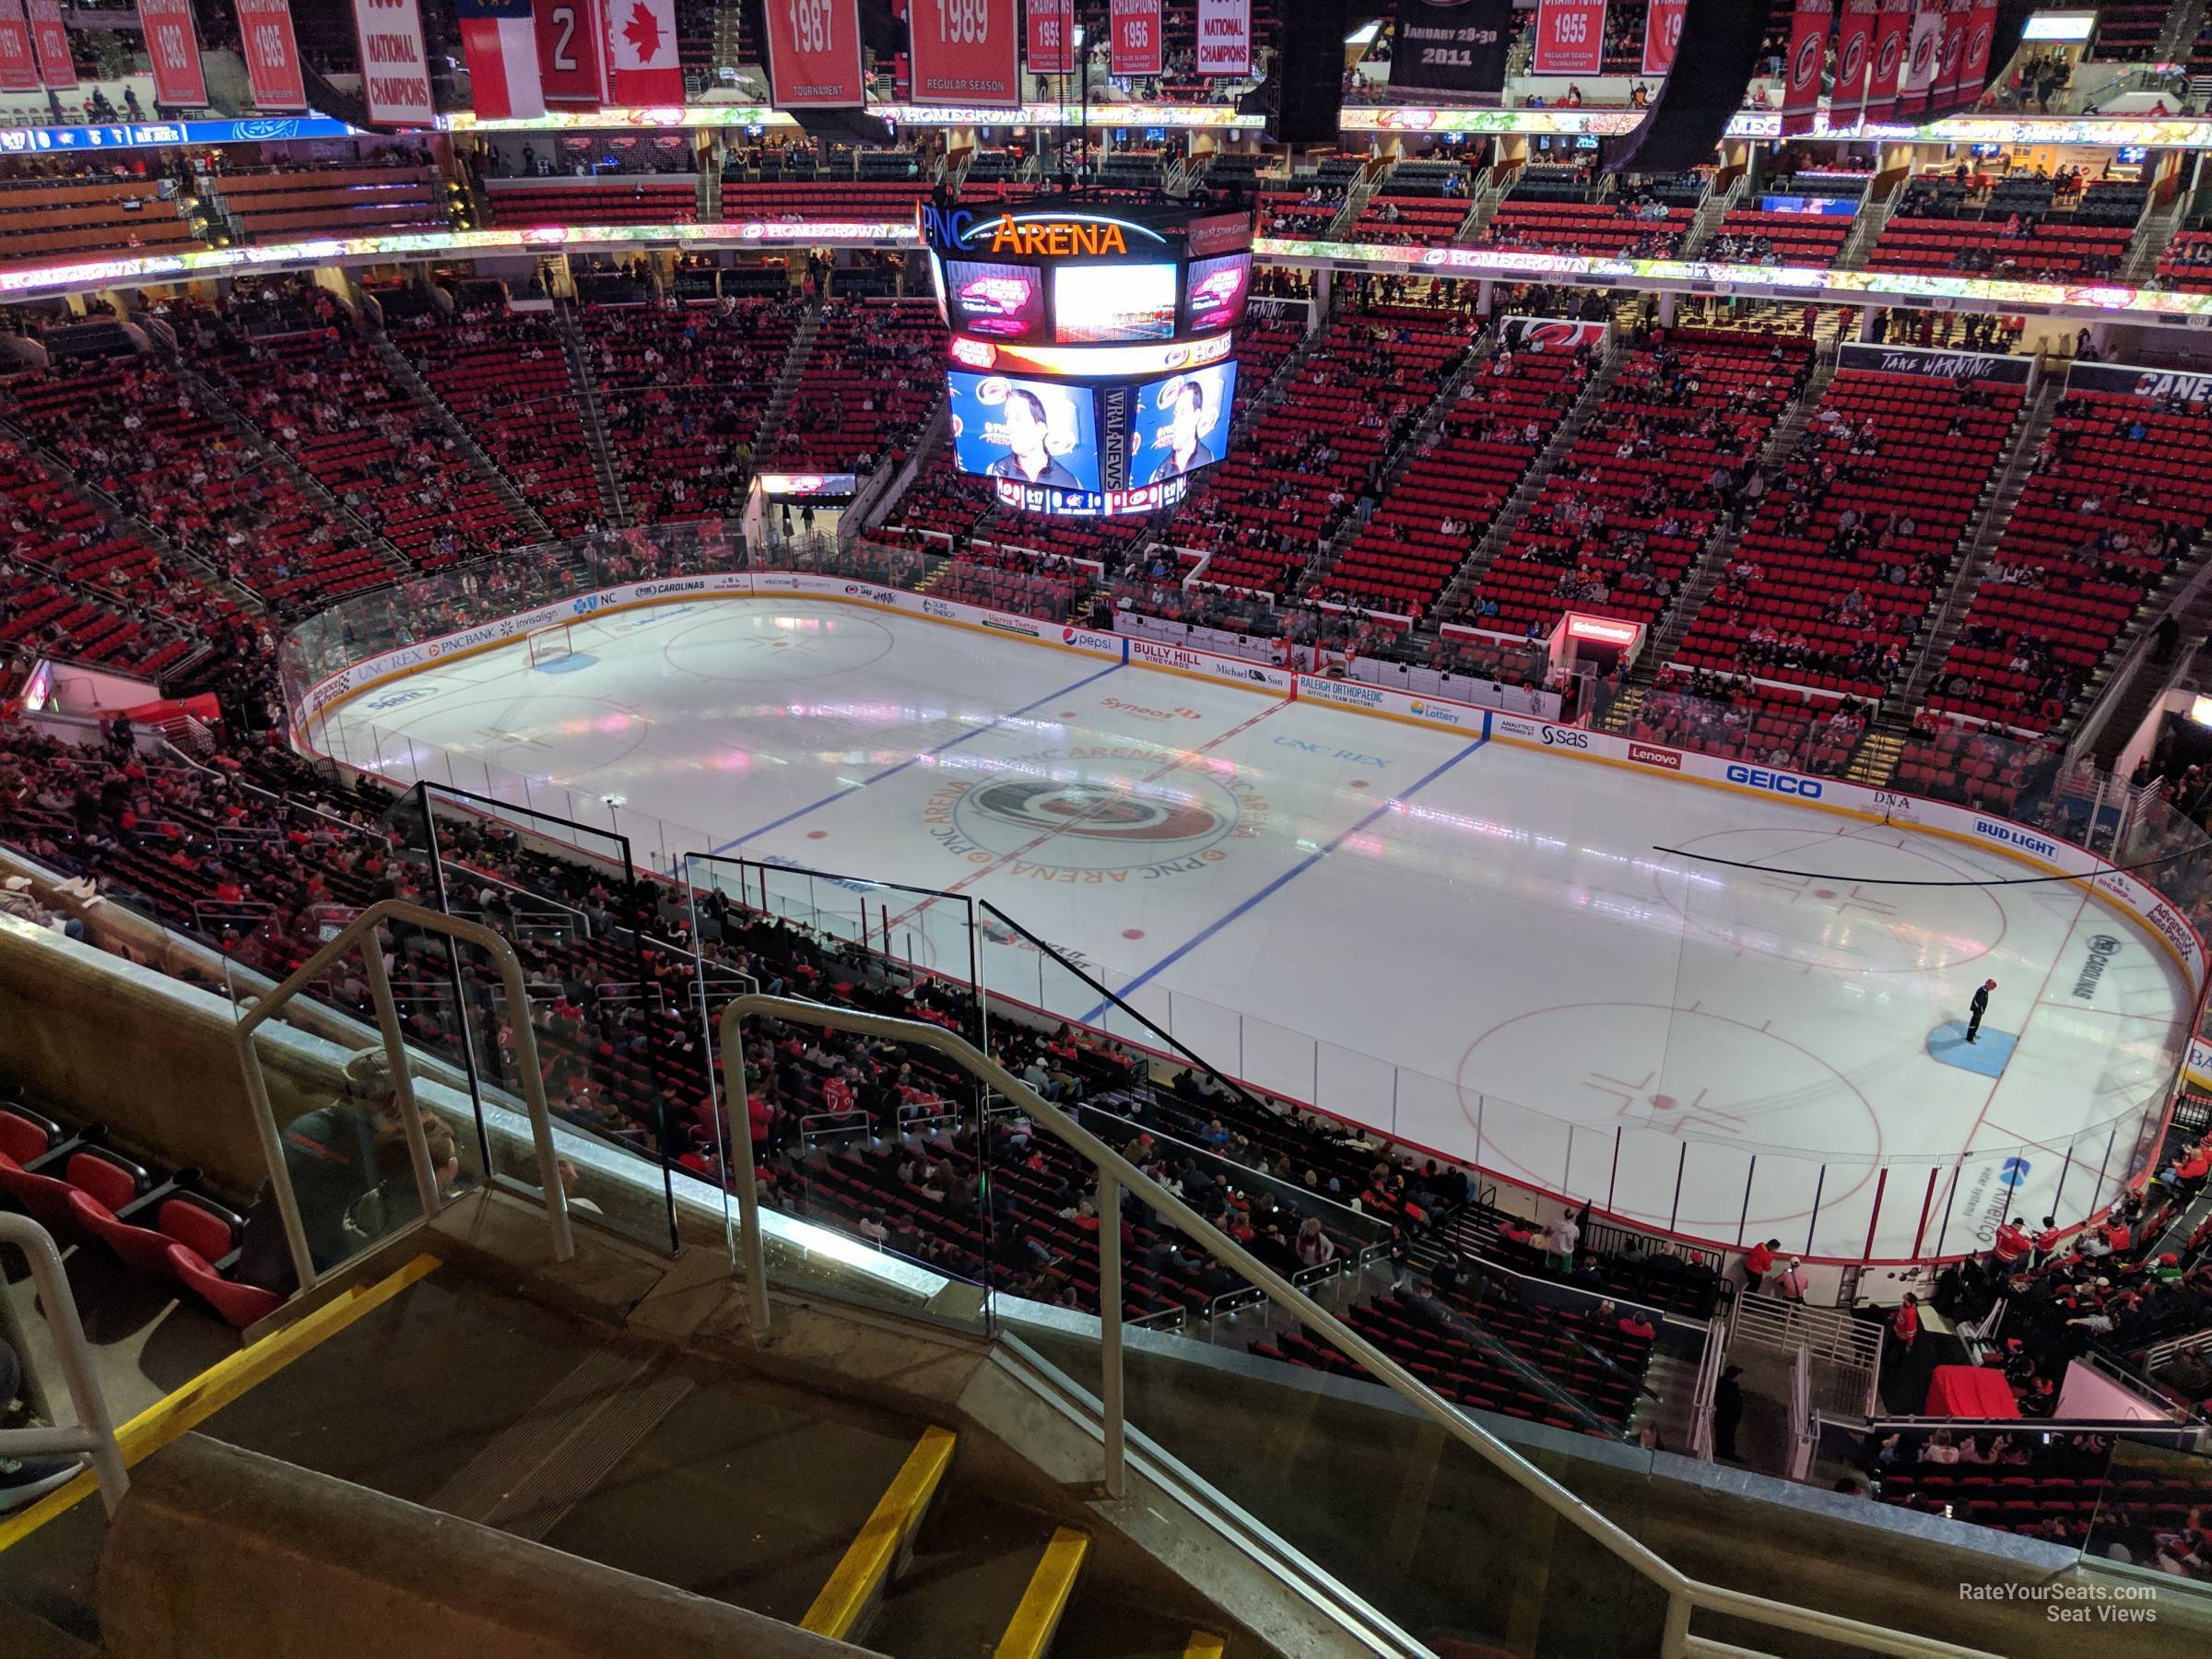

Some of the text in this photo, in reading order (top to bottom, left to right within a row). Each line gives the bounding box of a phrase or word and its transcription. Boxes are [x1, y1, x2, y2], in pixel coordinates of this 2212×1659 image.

[790, 0, 834, 53] 1987
[935, 0, 989, 44] 1989
[1204, 18, 1244, 37] NATIONAL
[1555, 13, 1588, 44] 1955
[552, 7, 577, 71] 2
[1123, 21, 1148, 47] 1956
[1456, 28, 1498, 44] 28-30
[255, 25, 286, 68] 1985
[367, 34, 418, 63] NATIONAL
[1200, 44, 1248, 63] CHAMPIONS
[1420, 47, 1473, 66] 2011
[371, 77, 429, 107] CHAMPIONS
[793, 85, 843, 96] TOURNAMENT
[926, 78, 1005, 91] REGULAR SEASON
[766, 223, 888, 238] HOMEGROWN
[922, 206, 975, 251] PNC
[992, 213, 1127, 255] ARENA
[1451, 250, 1590, 273] HOMEGROWN
[2188, 313, 2206, 326] 107
[1193, 340, 1231, 362] HOME
[1107, 391, 1124, 490] WRAL NEWS
[657, 581, 705, 593] CAROLINAS
[600, 593, 618, 606] NC
[933, 601, 948, 610] DUKE
[516, 608, 558, 629] invisalign
[933, 608, 956, 619] ENERGY
[988, 613, 1013, 626] Harris
[1015, 619, 1040, 632] Teeter
[1078, 634, 1112, 650] pepsi
[1134, 642, 1202, 665] BULLY HILL
[358, 648, 424, 680] UNC REX
[1145, 654, 1190, 670] VINEYARDS
[1216, 663, 1284, 687] Michael Son
[368, 688, 424, 711] Spirit
[1300, 677, 1383, 703] RALEIGH ORTHOPAEDIC
[1307, 689, 1375, 708] OFFICIAL TEAM DOCTORS
[1100, 697, 1175, 720] Syneos
[1425, 708, 1460, 724] Lottery
[1500, 726, 1524, 736] POWERED
[1501, 720, 1535, 732] ANALYTICS
[1275, 736, 1394, 769] UNC REX
[1631, 747, 1677, 766] Lenovo
[1726, 764, 1823, 800] GEICO
[924, 781, 973, 826] ARENA
[1874, 792, 1911, 809] DNA
[1976, 820, 2057, 857] BUD LIGHT
[1010, 857, 1206, 885] PNC ARENA
[2145, 911, 2184, 952] Auto Parts
[2153, 902, 2188, 940] Advance
[2073, 953, 2109, 1000] CAROLINAS
